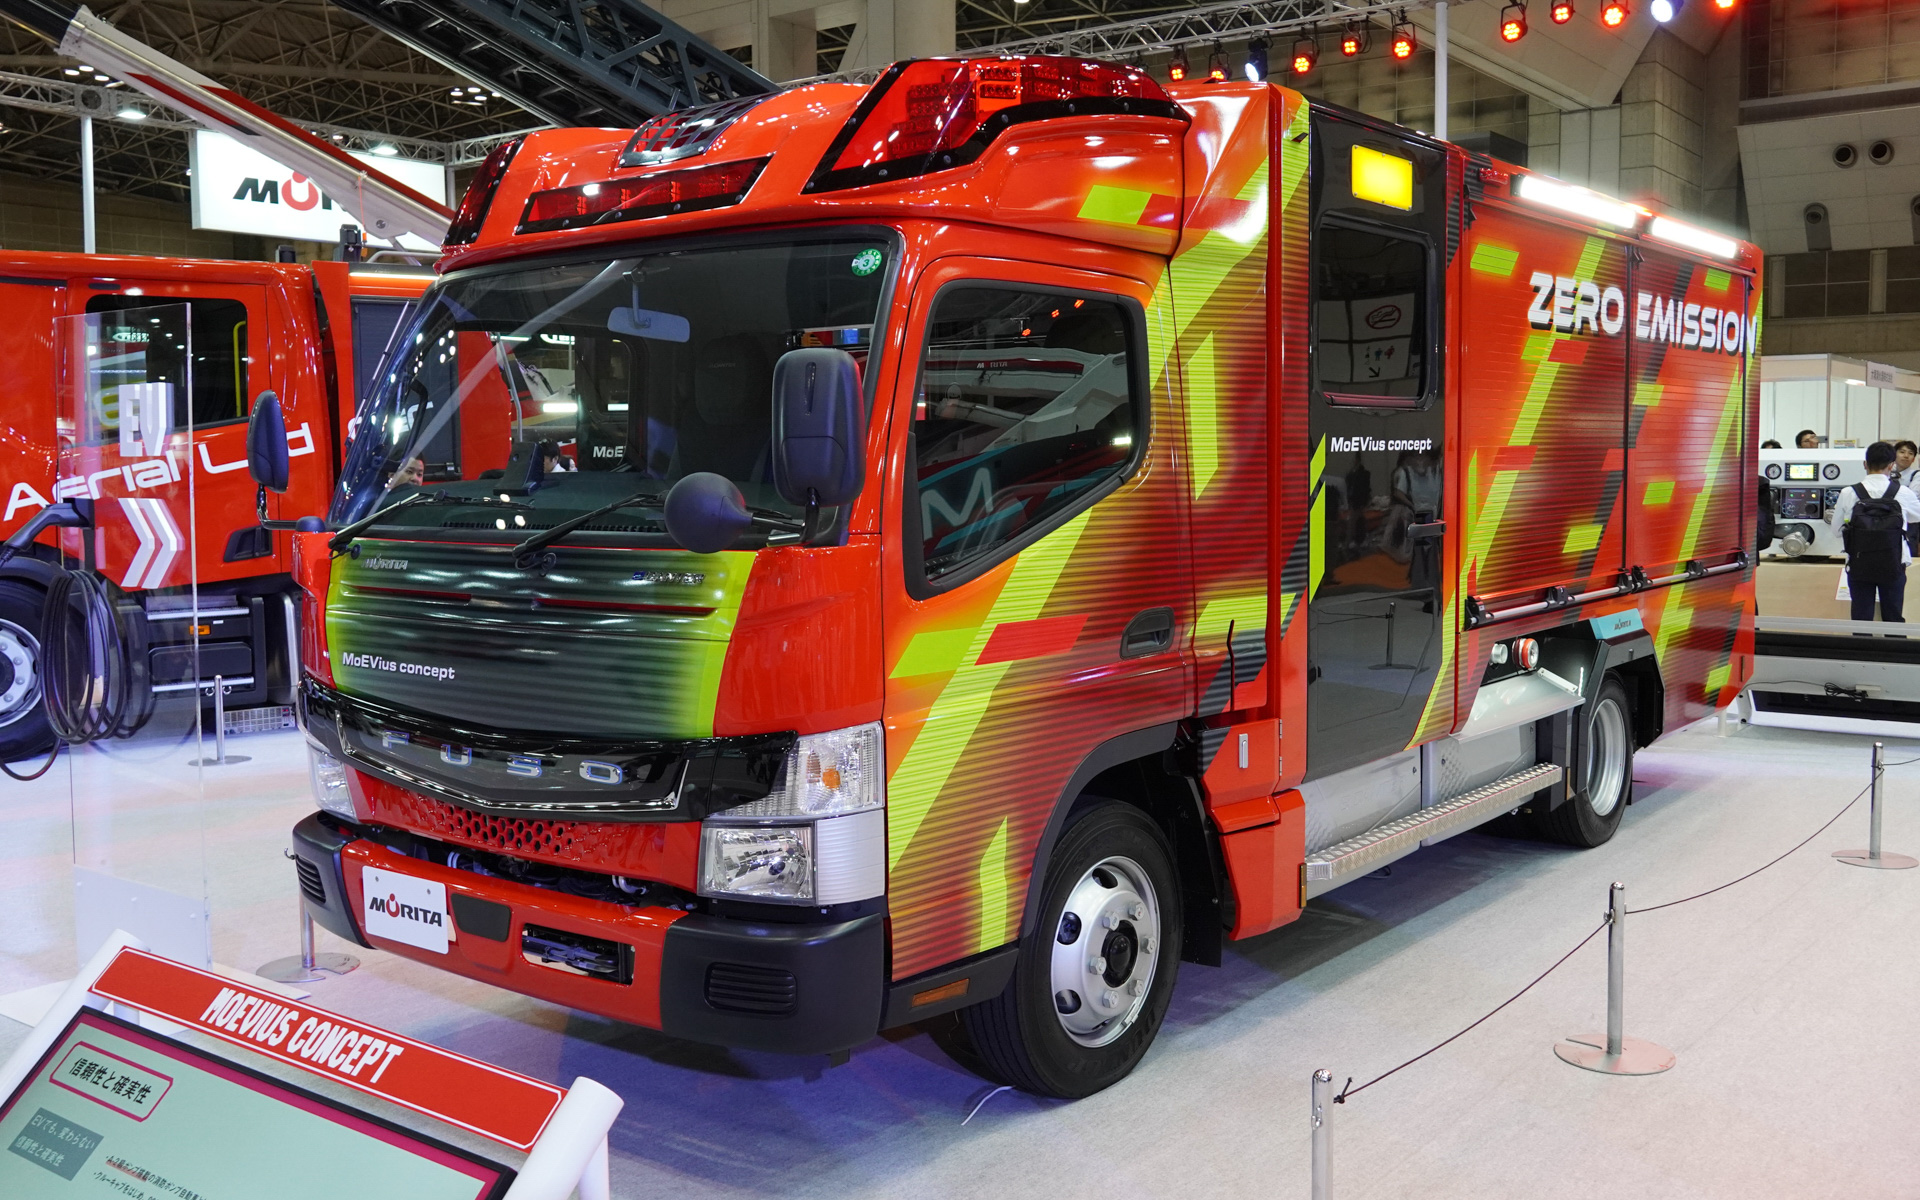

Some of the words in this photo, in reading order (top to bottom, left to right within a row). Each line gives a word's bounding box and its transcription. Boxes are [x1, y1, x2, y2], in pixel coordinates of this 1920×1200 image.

[1527, 271, 1625, 335] ZERO
[1634, 291, 1757, 356] EMISSION
[119, 382, 174, 457] EV
[1330, 436, 1386, 453] MoEVius
[1387, 437, 1432, 454] concept
[3, 451, 181, 521] Aerial
[342, 651, 397, 672] MoEVius
[399, 661, 456, 681] concept
[382, 729, 624, 785] FUSO
[369, 893, 442, 927] MORITA
[199, 986, 300, 1047] MOEVIUS
[286, 1016, 405, 1084] CONCEPT
[68, 1057, 152, 1105] 信頼性と確実性
